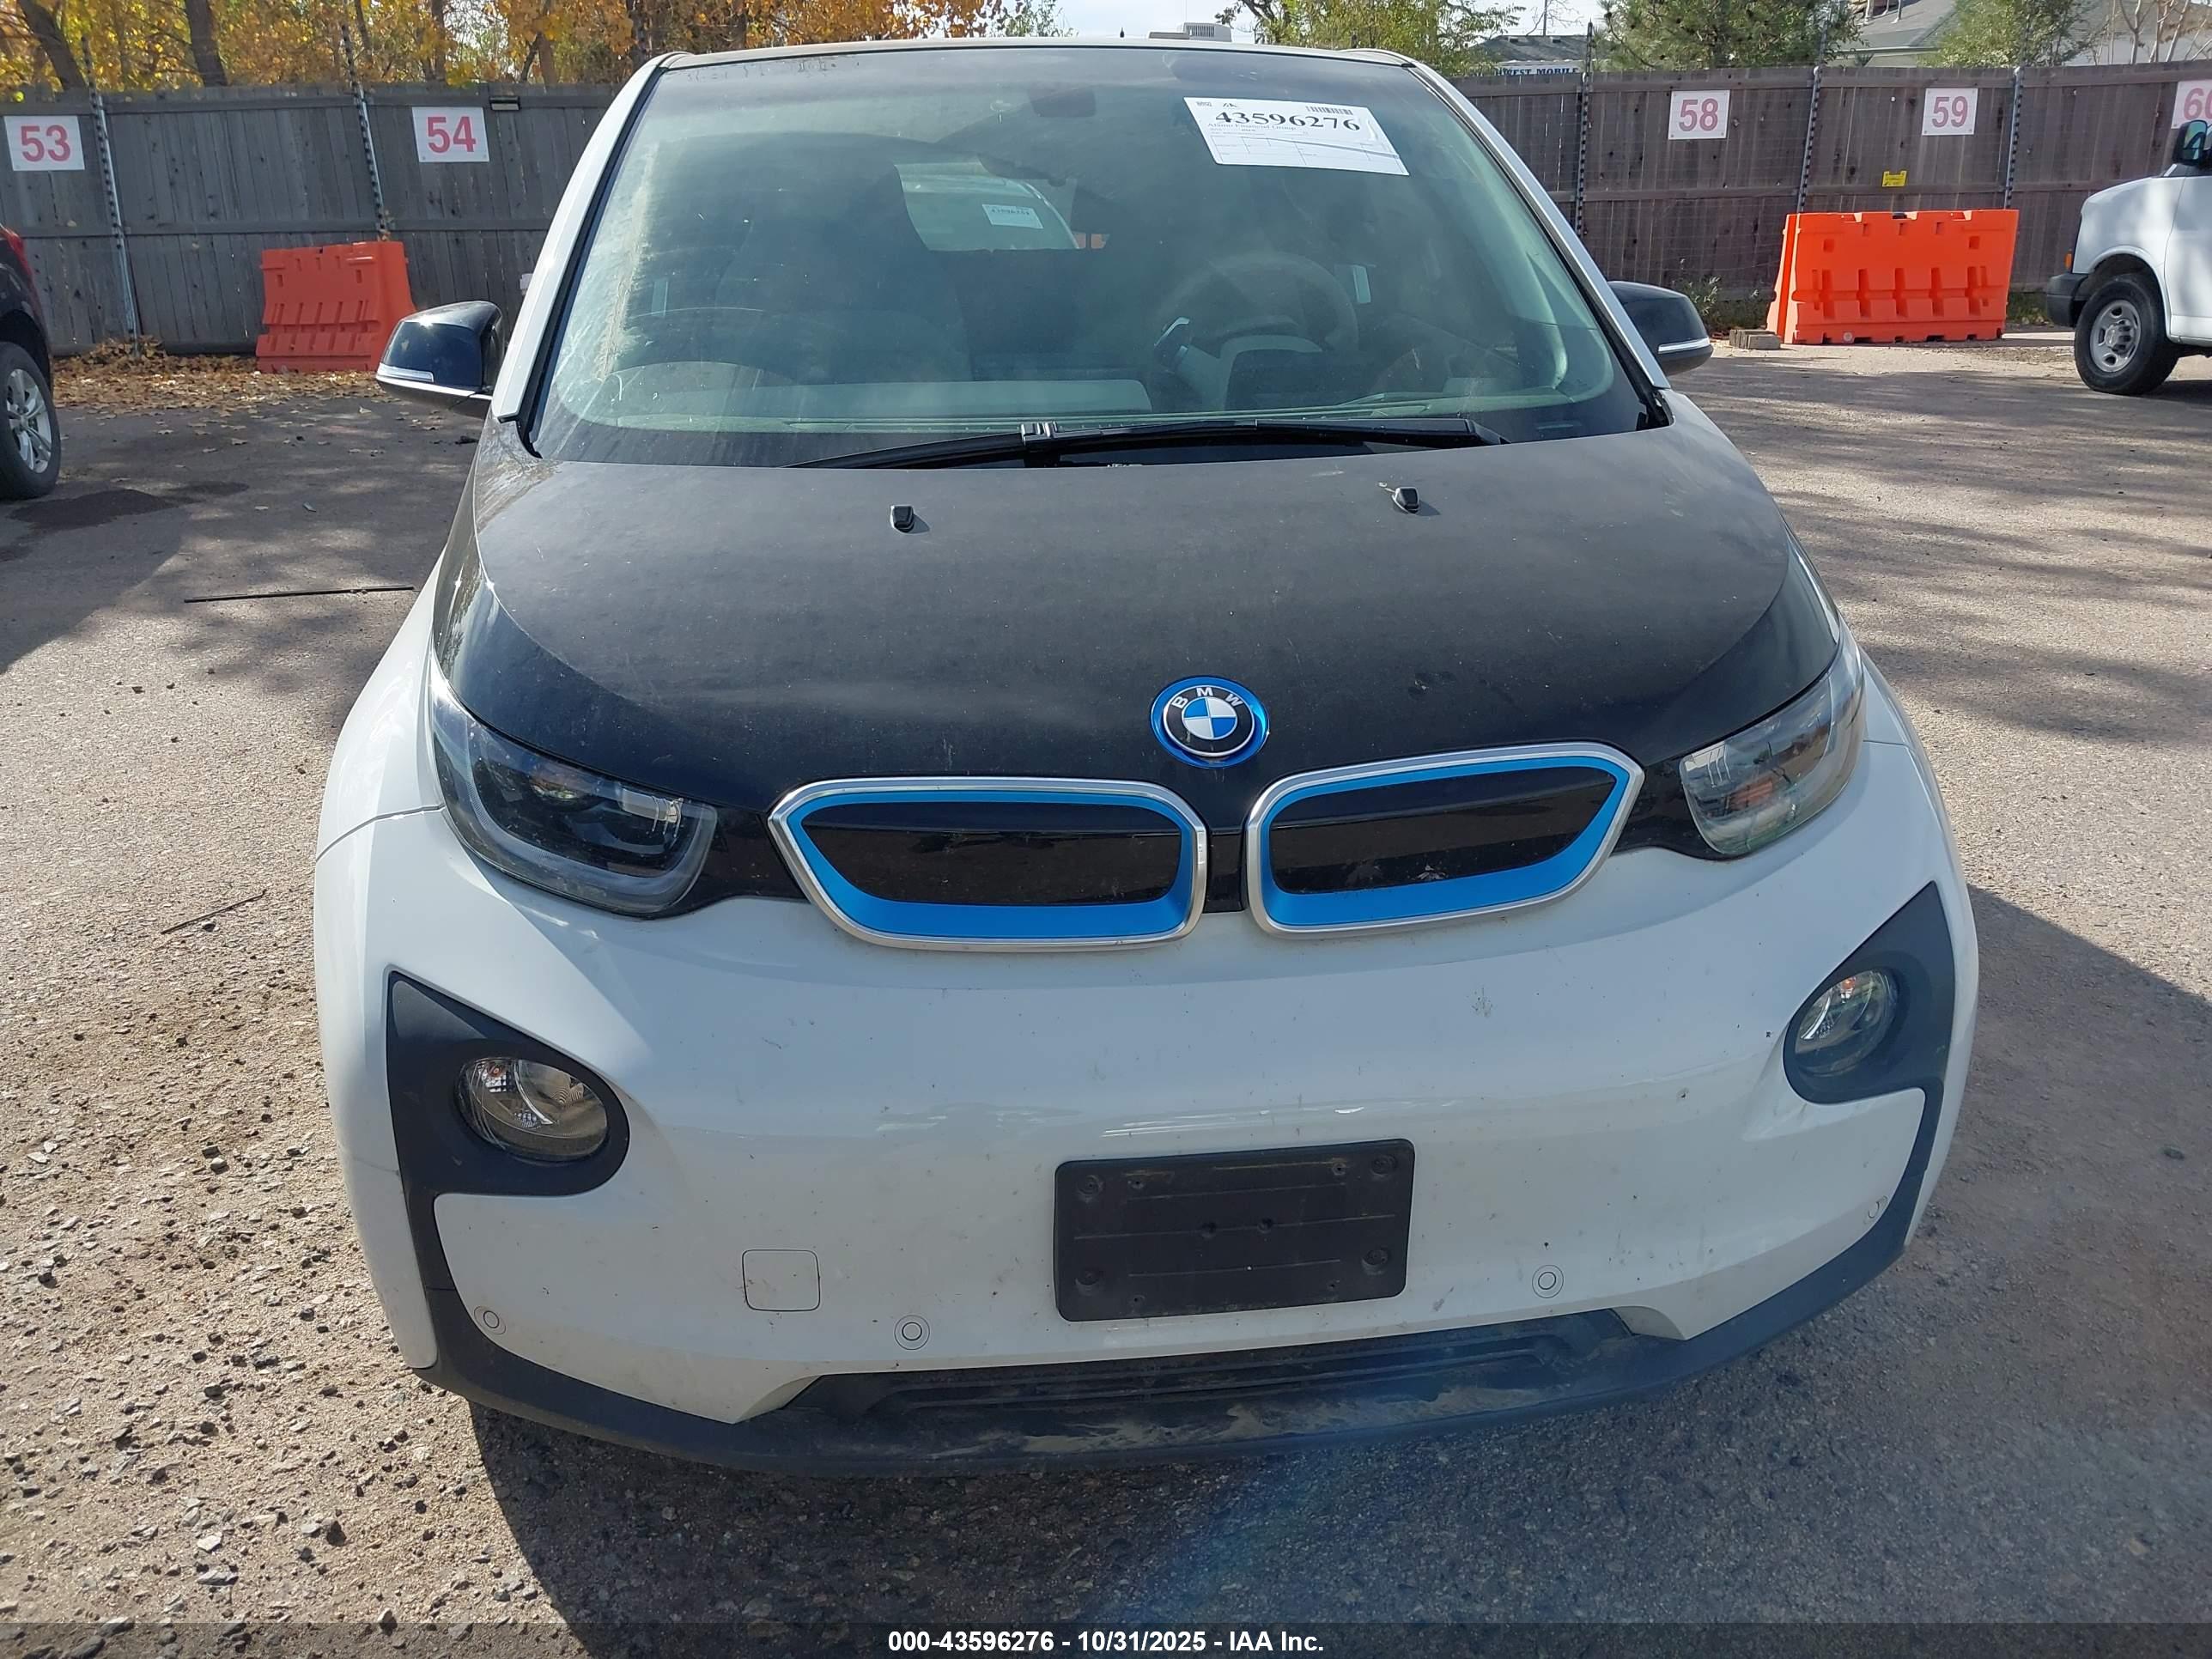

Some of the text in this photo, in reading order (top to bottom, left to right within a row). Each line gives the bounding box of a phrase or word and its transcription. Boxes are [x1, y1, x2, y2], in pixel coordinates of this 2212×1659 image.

[1214, 111, 1361, 131] 43596276
[1678, 97, 1719, 132] 58
[1931, 95, 1969, 128] 59
[20, 125, 71, 161] 53
[427, 116, 477, 153] 54
[1171, 687, 1243, 708] BMW
